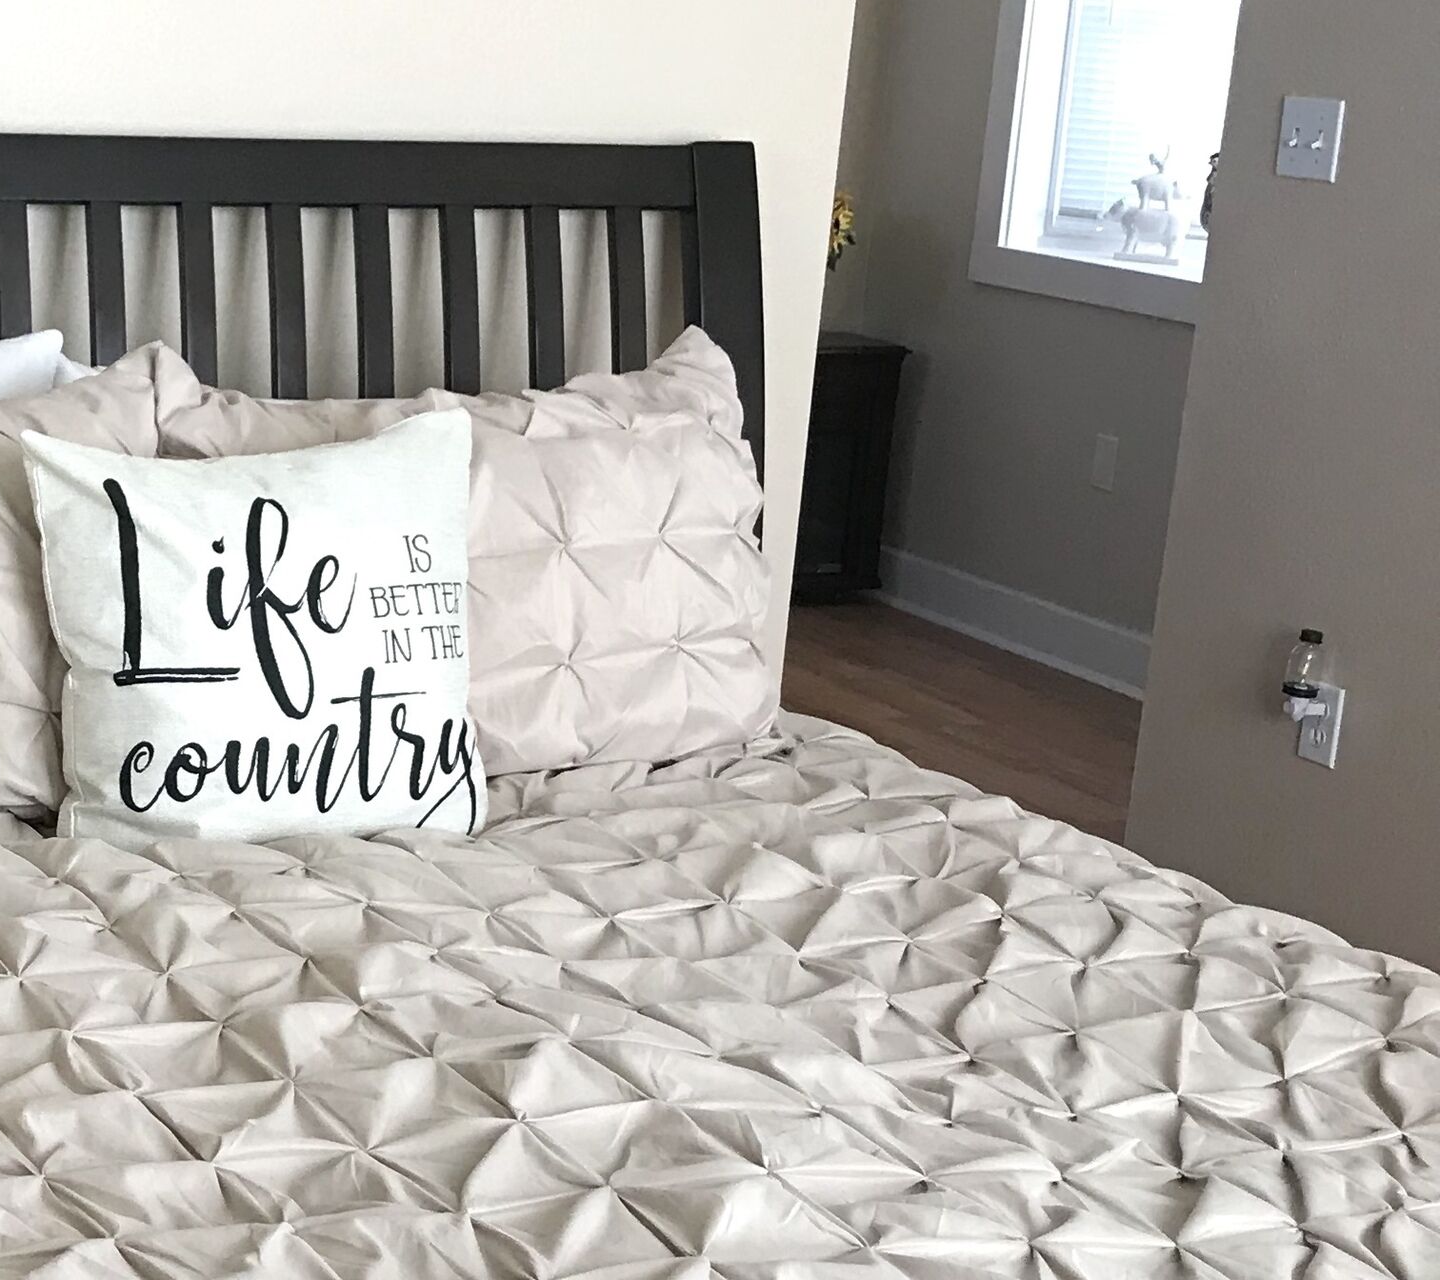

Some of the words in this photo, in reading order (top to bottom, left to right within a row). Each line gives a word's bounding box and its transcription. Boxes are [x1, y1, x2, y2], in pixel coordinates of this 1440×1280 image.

[102, 478, 358, 720] Life
[402, 533, 432, 573] IS
[381, 627, 412, 664] IN
[420, 624, 465, 660] THE
[118, 666, 477, 836] country
